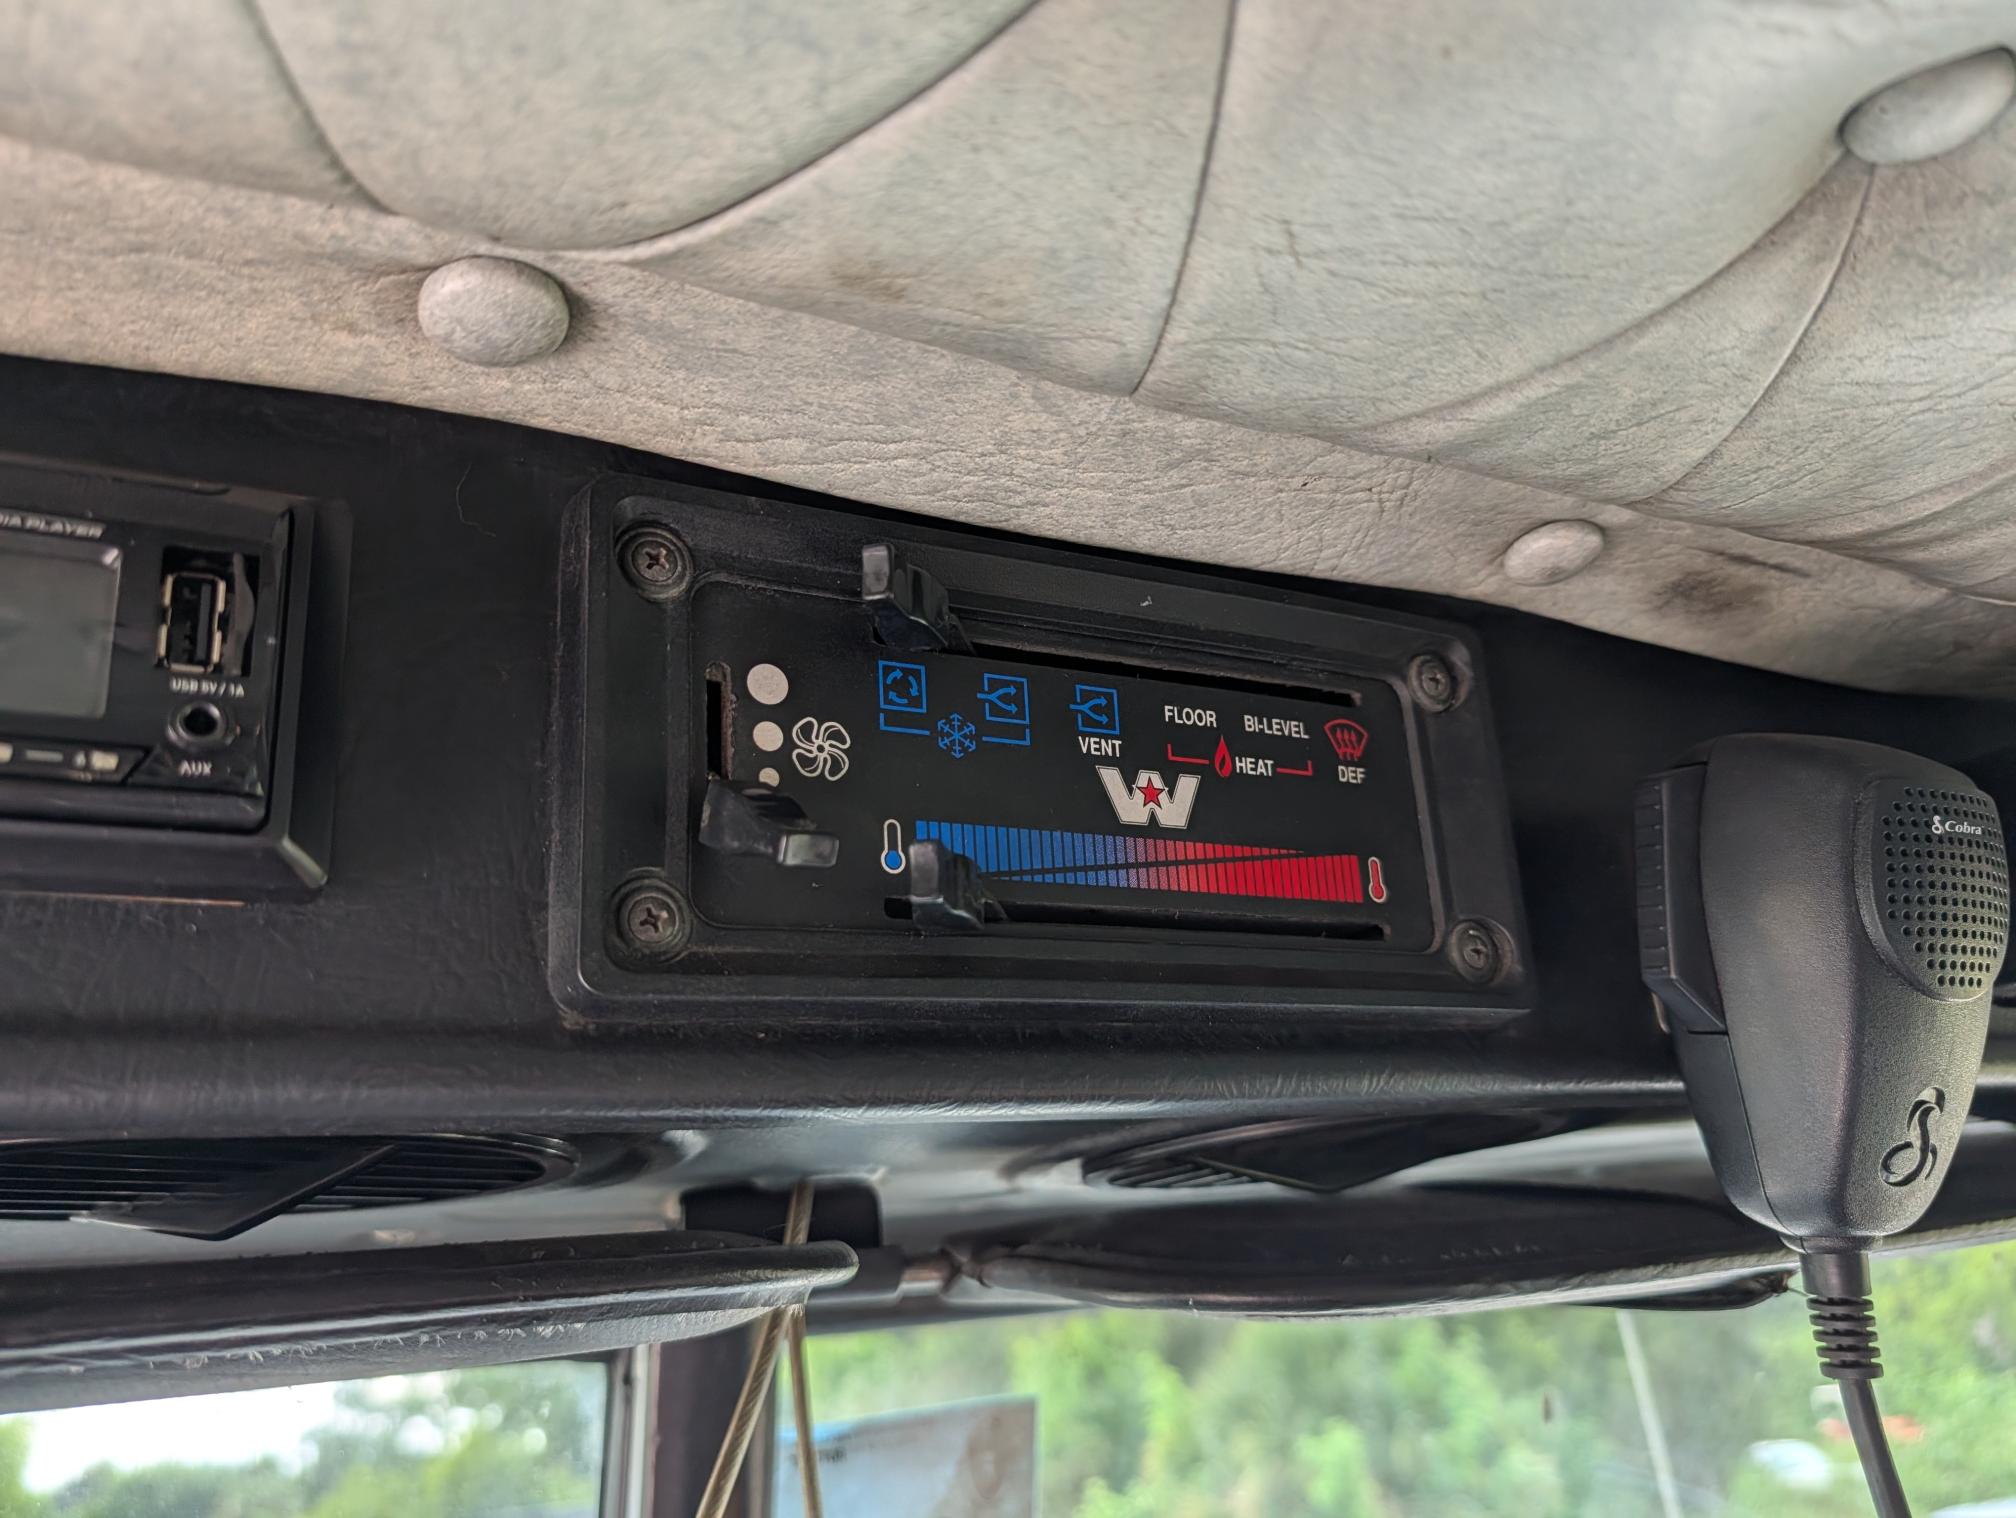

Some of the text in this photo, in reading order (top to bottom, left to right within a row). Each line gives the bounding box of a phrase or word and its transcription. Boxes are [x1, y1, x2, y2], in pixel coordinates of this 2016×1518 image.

[25, 515, 104, 538] PLAYER
[171, 677, 199, 695] USB
[1164, 705, 1217, 728] FLOOR
[1243, 715, 1310, 739] BI-LEVEL
[1078, 736, 1122, 758] VENT
[179, 760, 212, 777] AUX
[1235, 757, 1274, 777] HEAT
[1337, 765, 1366, 784] DEF
[1944, 820, 1982, 835] Cobra
